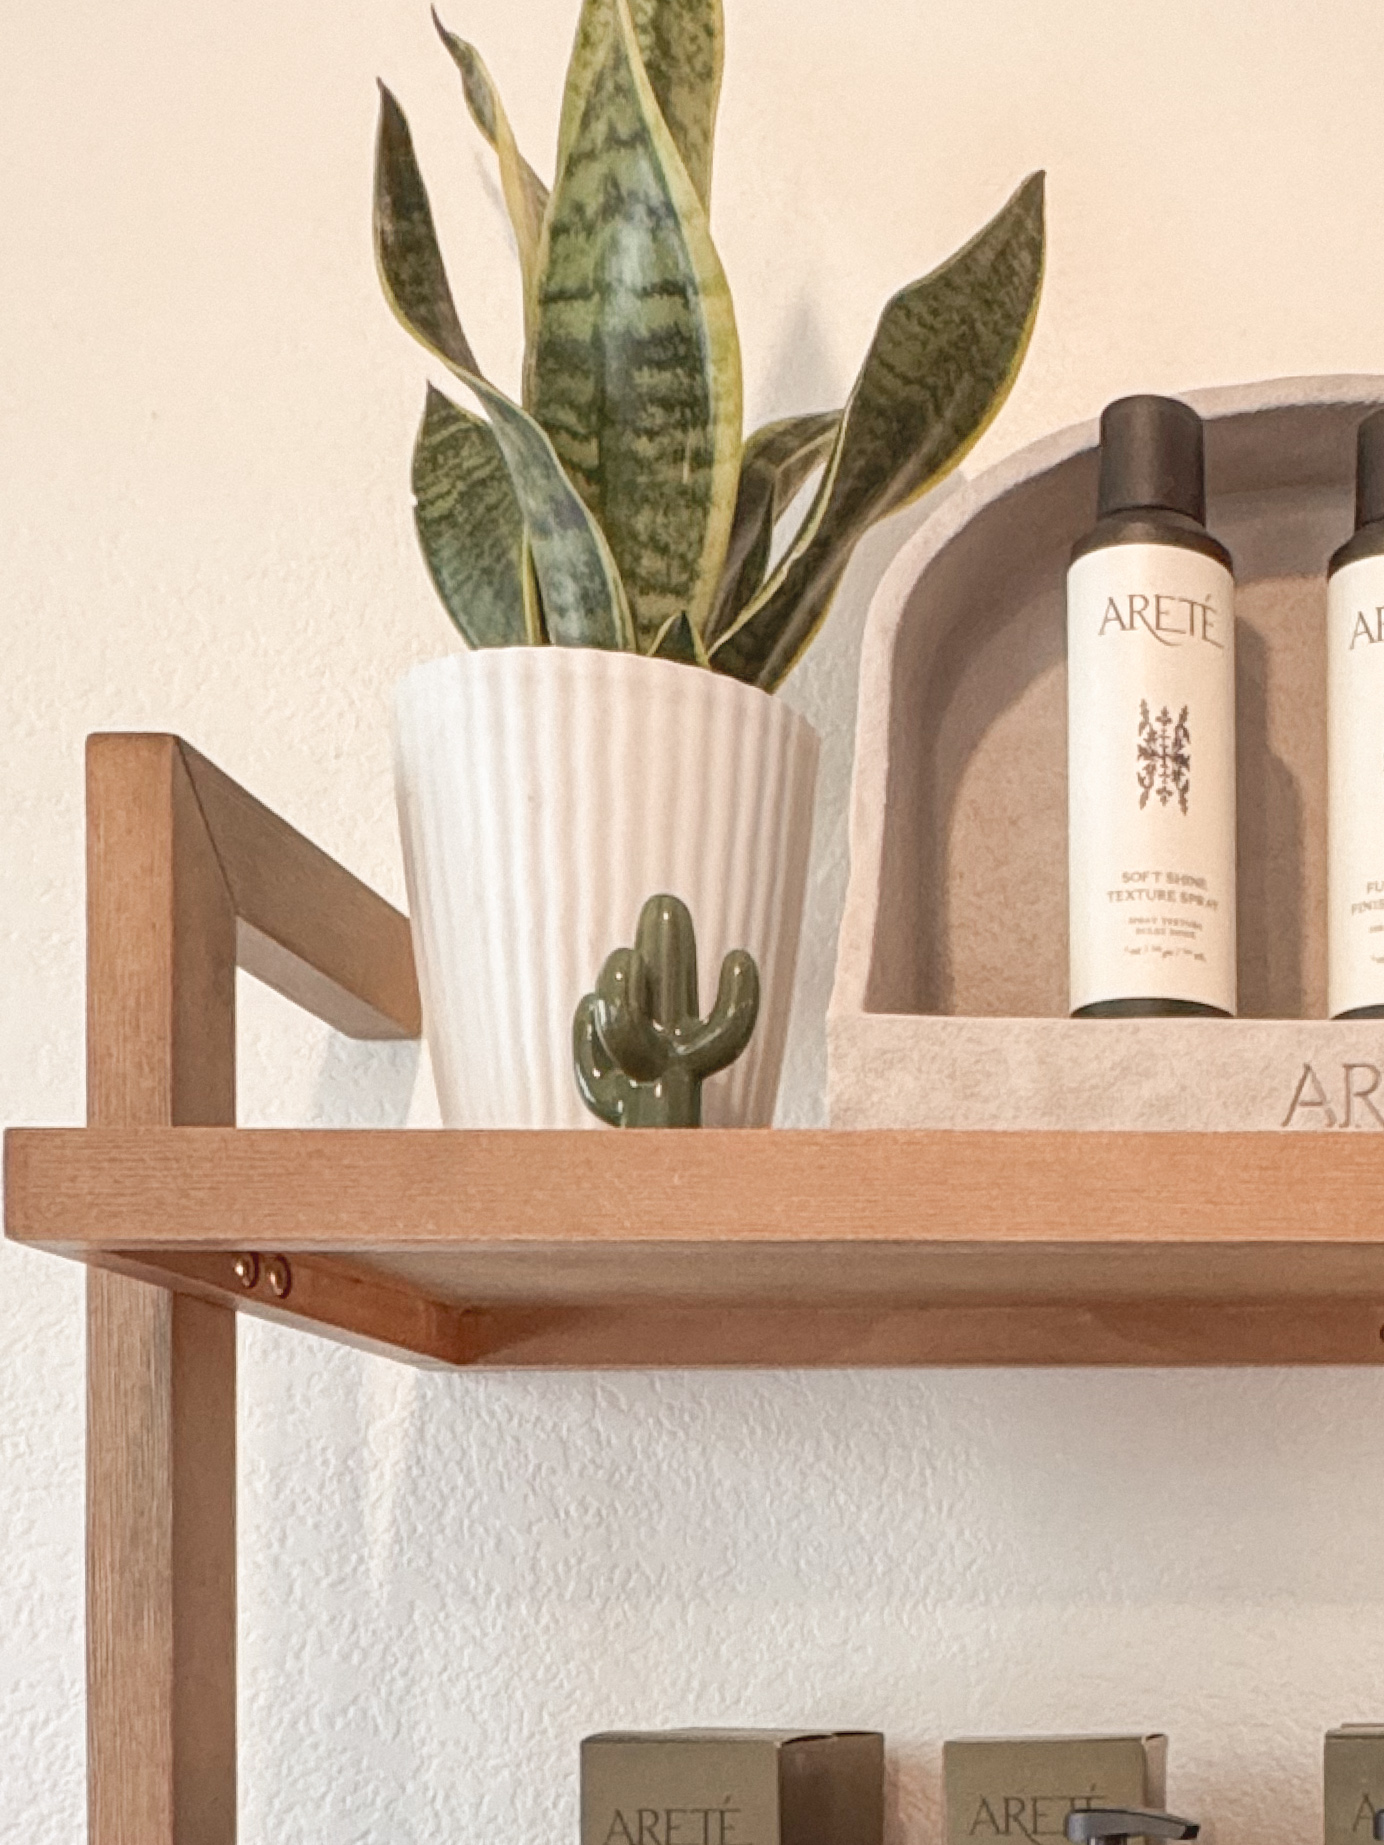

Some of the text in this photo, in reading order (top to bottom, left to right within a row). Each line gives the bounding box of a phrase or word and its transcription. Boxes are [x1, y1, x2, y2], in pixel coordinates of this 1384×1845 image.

[1098, 593, 1225, 649] ARETÉ
[1122, 870, 1162, 884] SOFT
[1107, 888, 1176, 903] TEXTURE
